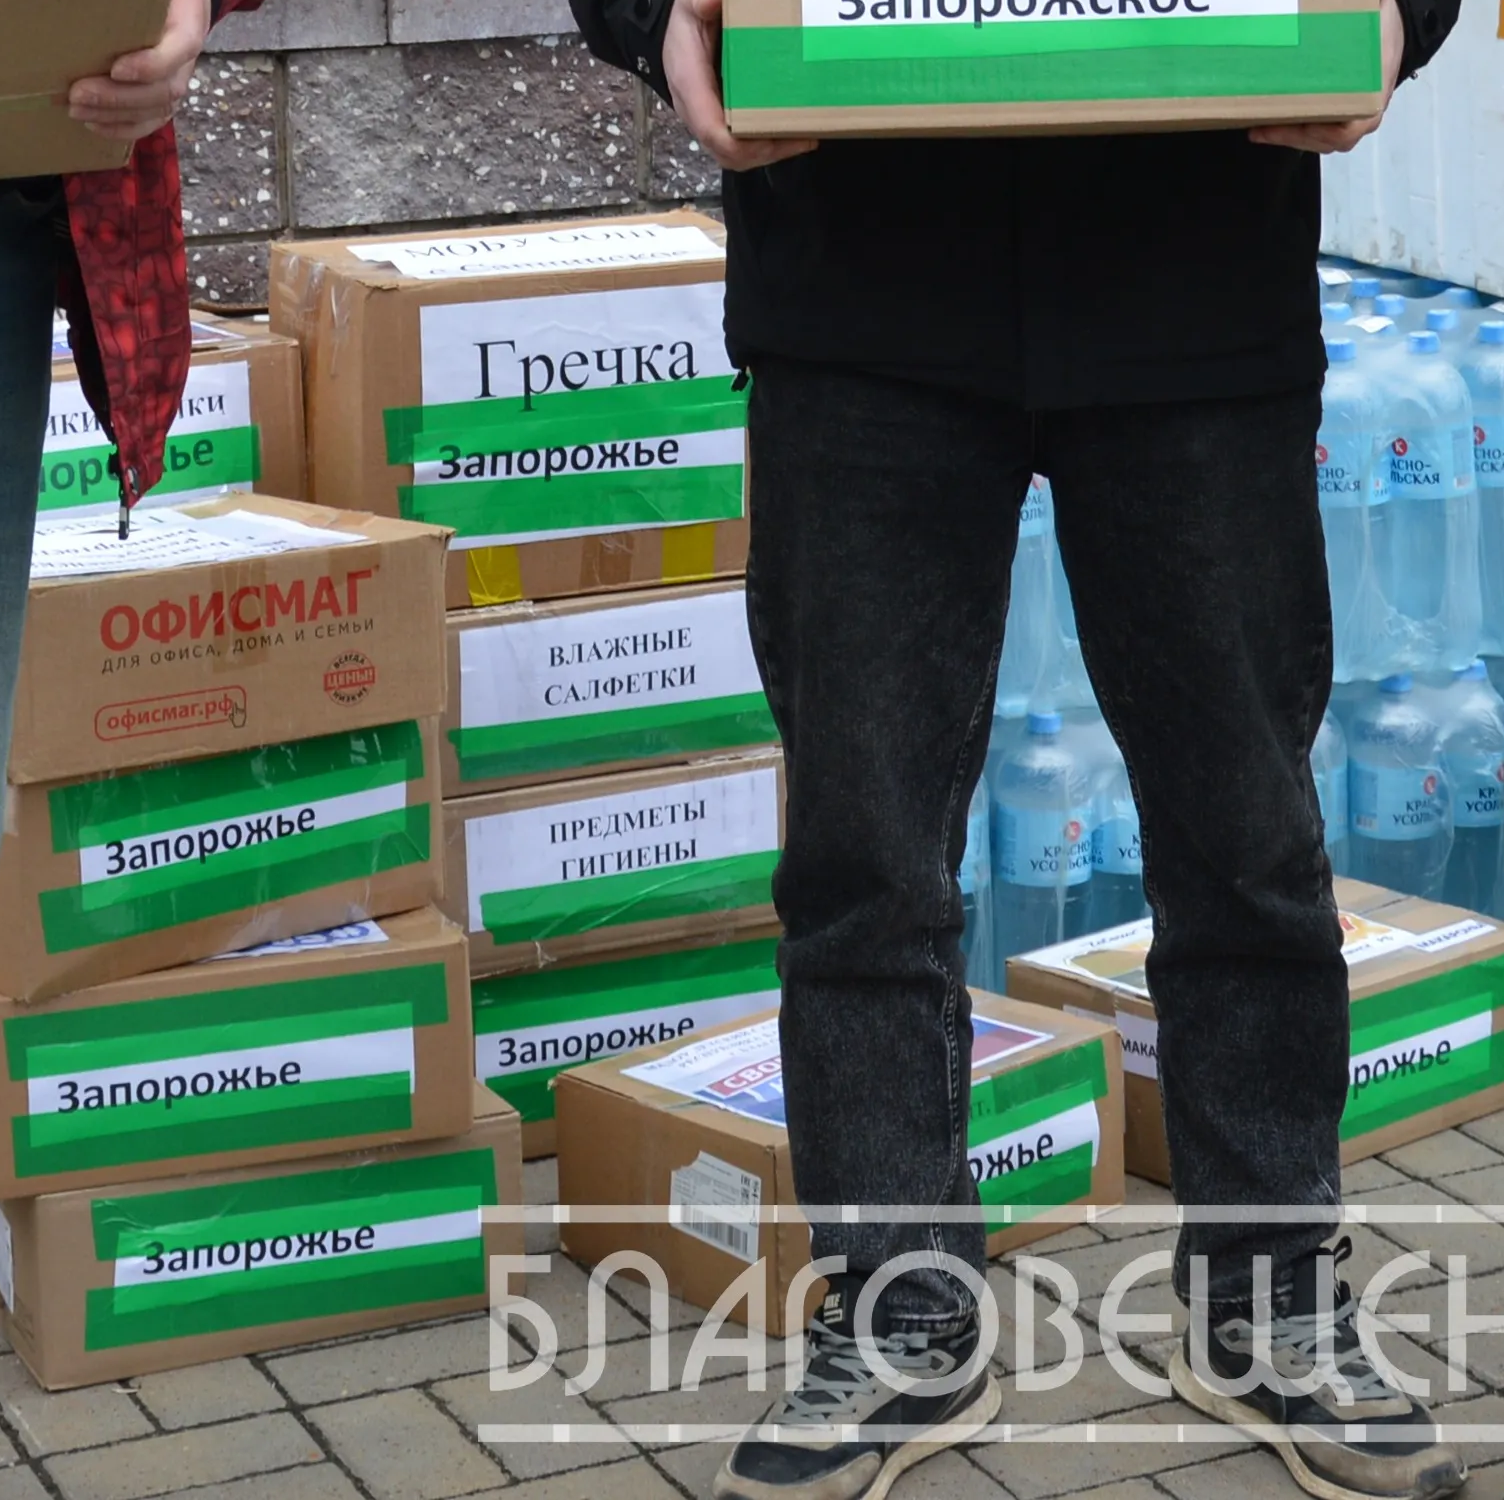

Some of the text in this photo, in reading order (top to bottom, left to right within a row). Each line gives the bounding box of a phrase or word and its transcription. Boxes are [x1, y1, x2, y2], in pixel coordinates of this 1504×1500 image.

[473, 340, 699, 412] Гречка
[438, 438, 679, 482] Запорожье
[100, 569, 372, 652] ОФИСМАГ
[101, 618, 374, 675] ДЛЯ ОФИСА, ДОМА И СЕМЬИ
[549, 627, 692, 668] ВЛАЖНЫЕ
[326, 667, 373, 688] ЦЕНЫ!
[544, 665, 696, 707] САЛФЕТКИ
[107, 694, 233, 732] офисмаг.рф
[105, 804, 317, 876] Запорожье
[549, 800, 706, 844] ПРЕДМЕТЫ
[561, 839, 697, 881] ГИГИЕНЫ
[498, 1017, 694, 1068] Запорожье
[56, 1055, 303, 1115] Запорожье
[142, 1220, 376, 1277] Запорожье
